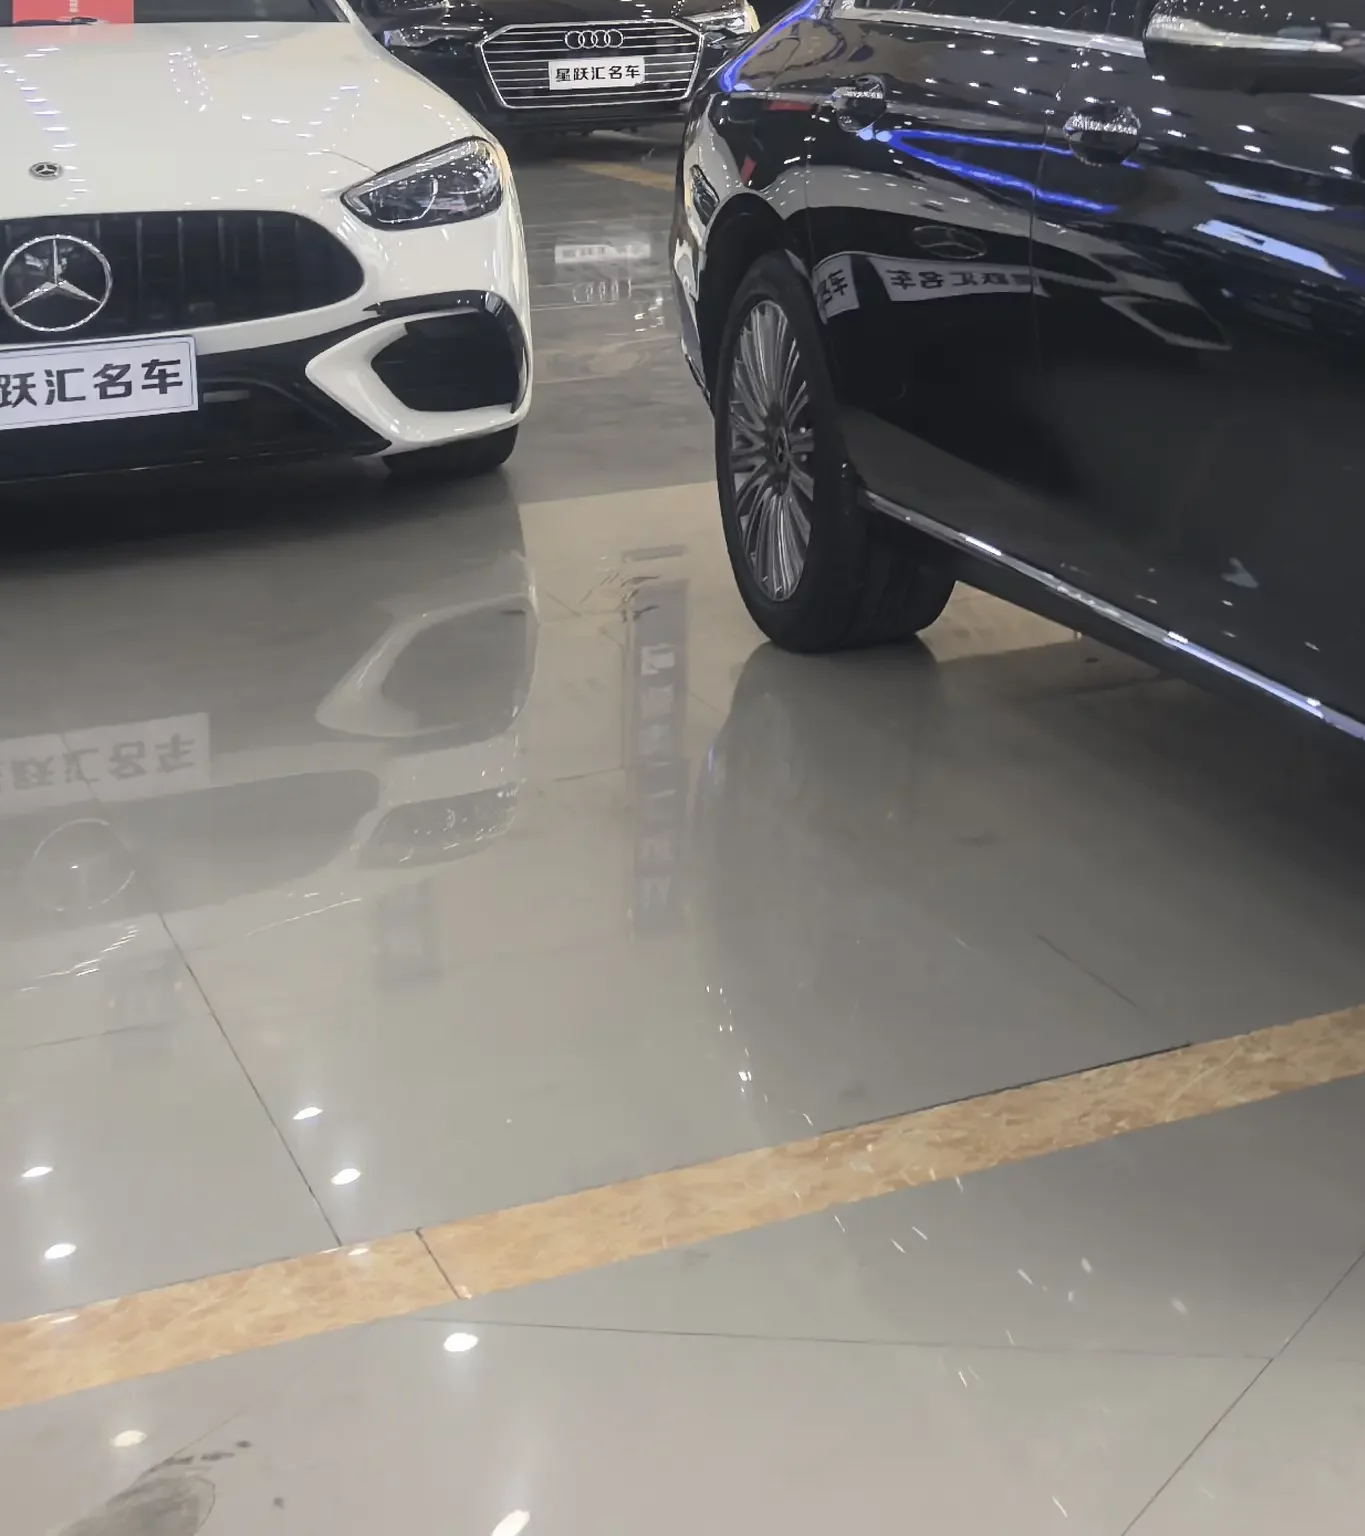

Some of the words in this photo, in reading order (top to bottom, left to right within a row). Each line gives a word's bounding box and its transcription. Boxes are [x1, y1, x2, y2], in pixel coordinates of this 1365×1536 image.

[556, 64, 640, 83] 星跃汇名车
[0, 359, 183, 409] 跃汇名车
